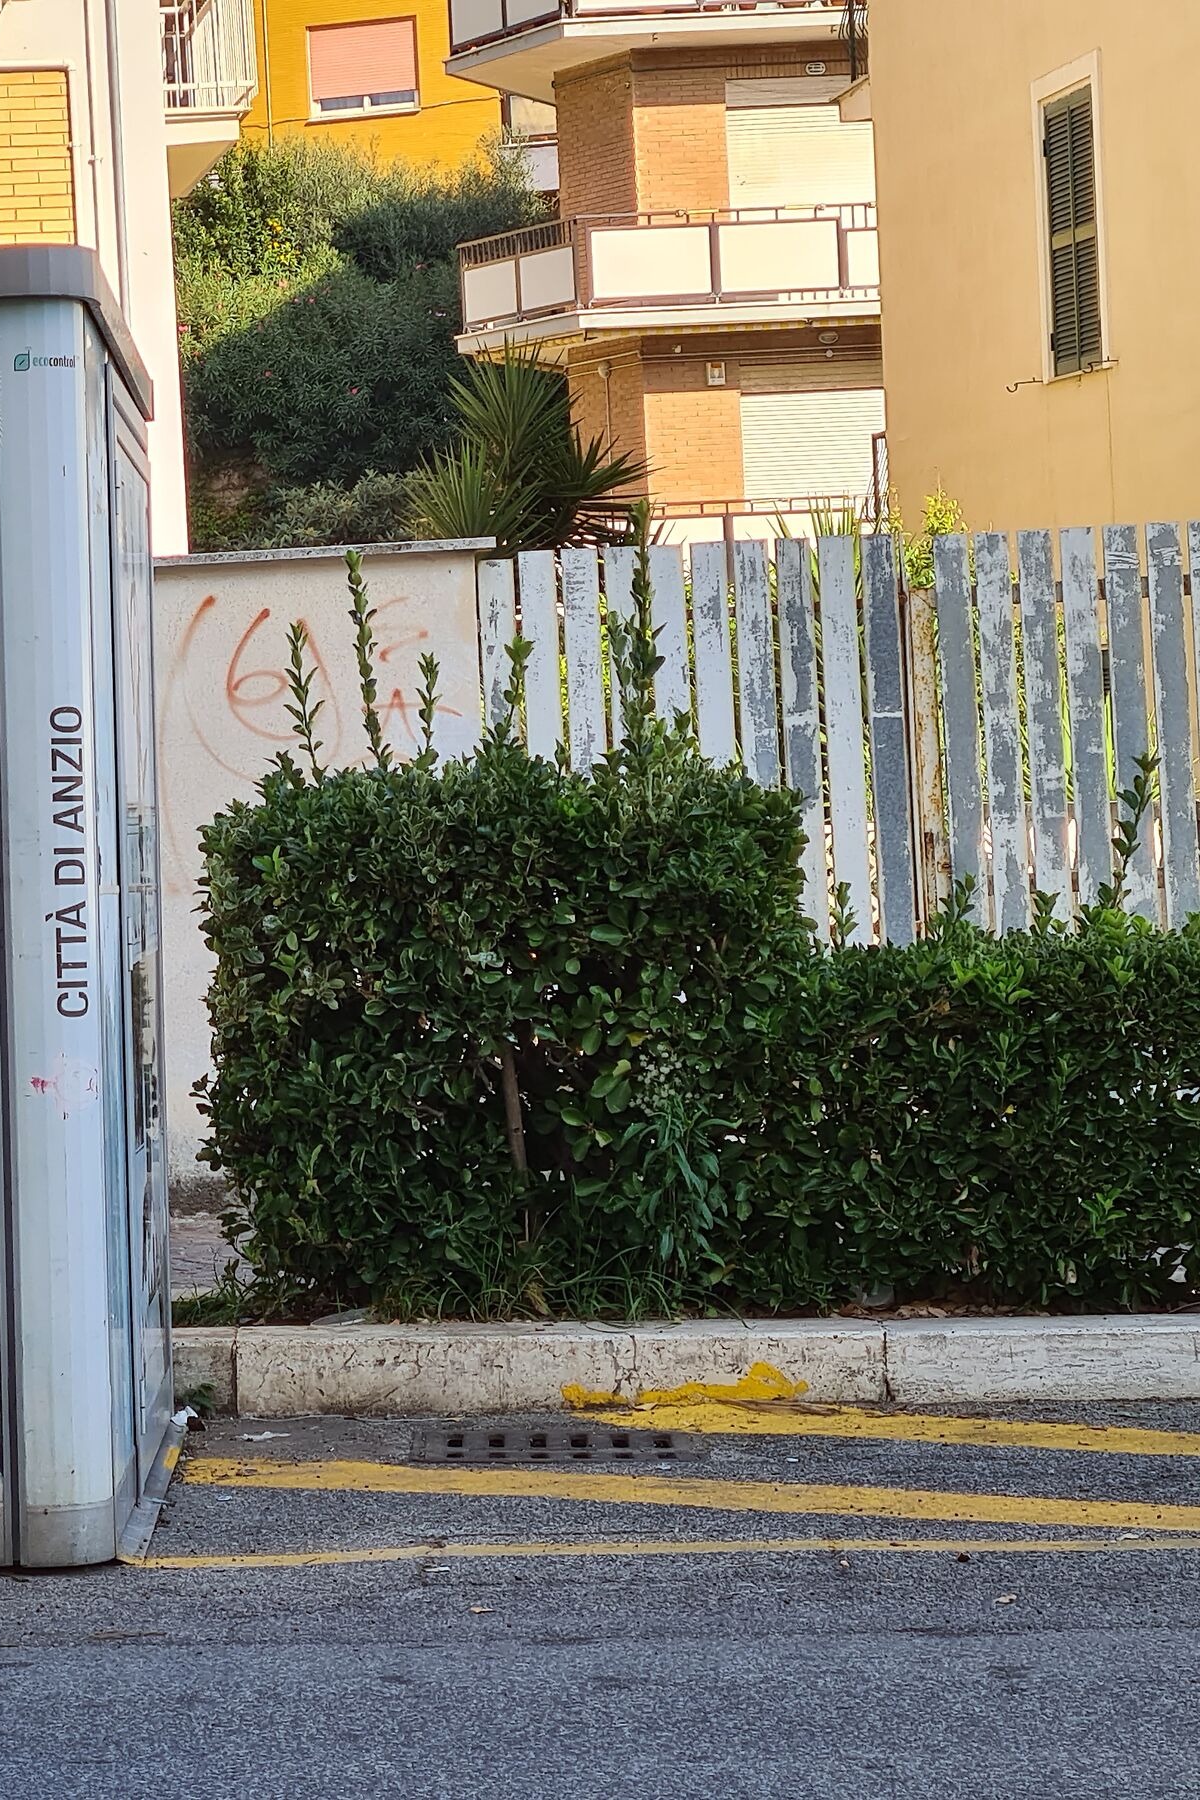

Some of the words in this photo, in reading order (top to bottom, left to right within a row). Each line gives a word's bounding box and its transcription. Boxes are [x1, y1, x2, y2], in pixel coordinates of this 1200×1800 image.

[49, 706, 85, 833] ANZIO
[53, 847, 85, 886] DI
[45, 900, 89, 1018] CITTÀ
